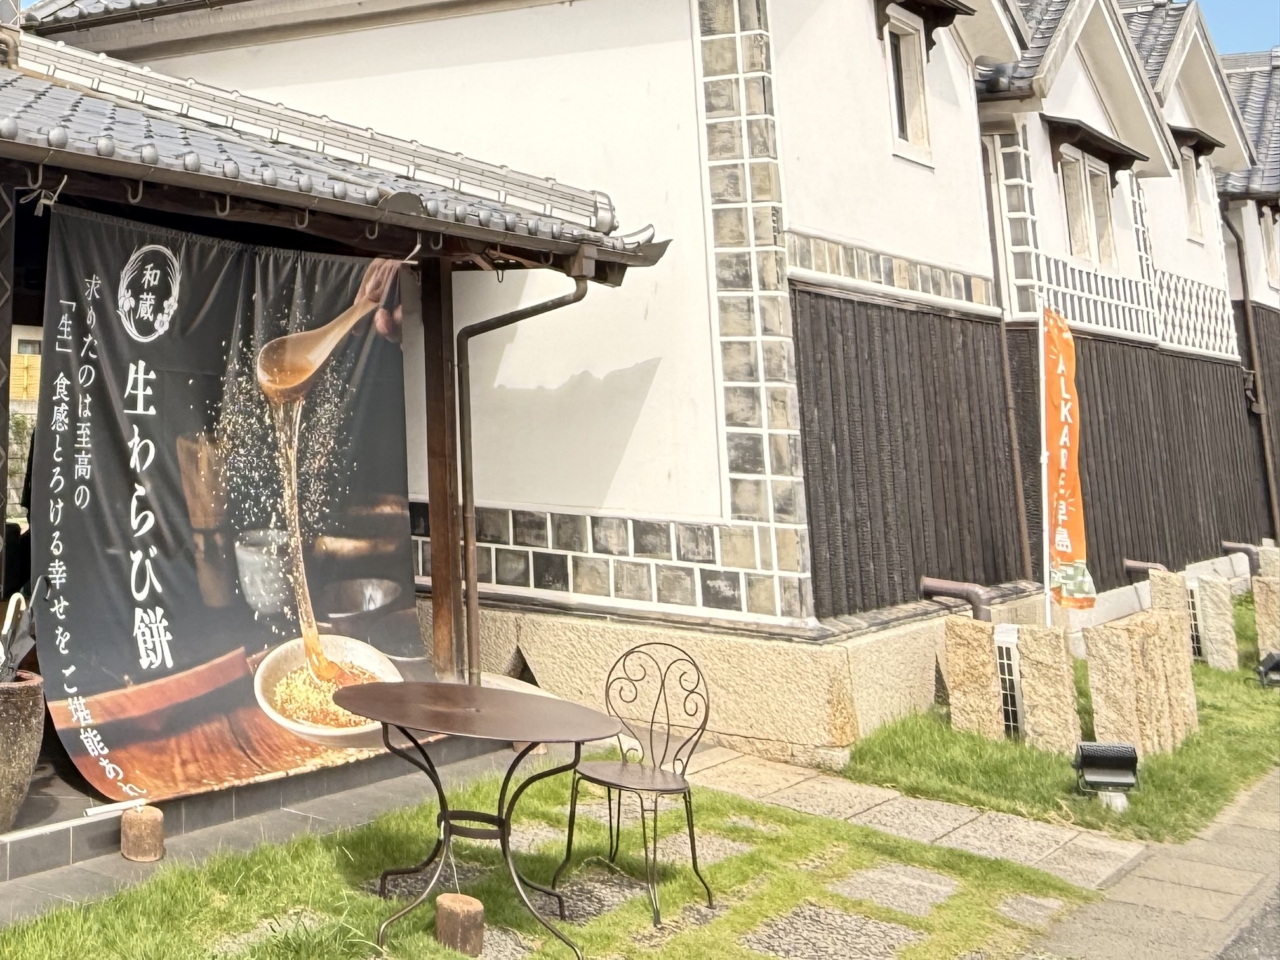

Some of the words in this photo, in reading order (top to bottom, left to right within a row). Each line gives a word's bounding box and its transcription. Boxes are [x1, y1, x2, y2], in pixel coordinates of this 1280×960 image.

[74, 274, 102, 510] 求めたのは至高の
[135, 263, 161, 322] 和蔵
[124, 359, 174, 670] 生わらび餅
